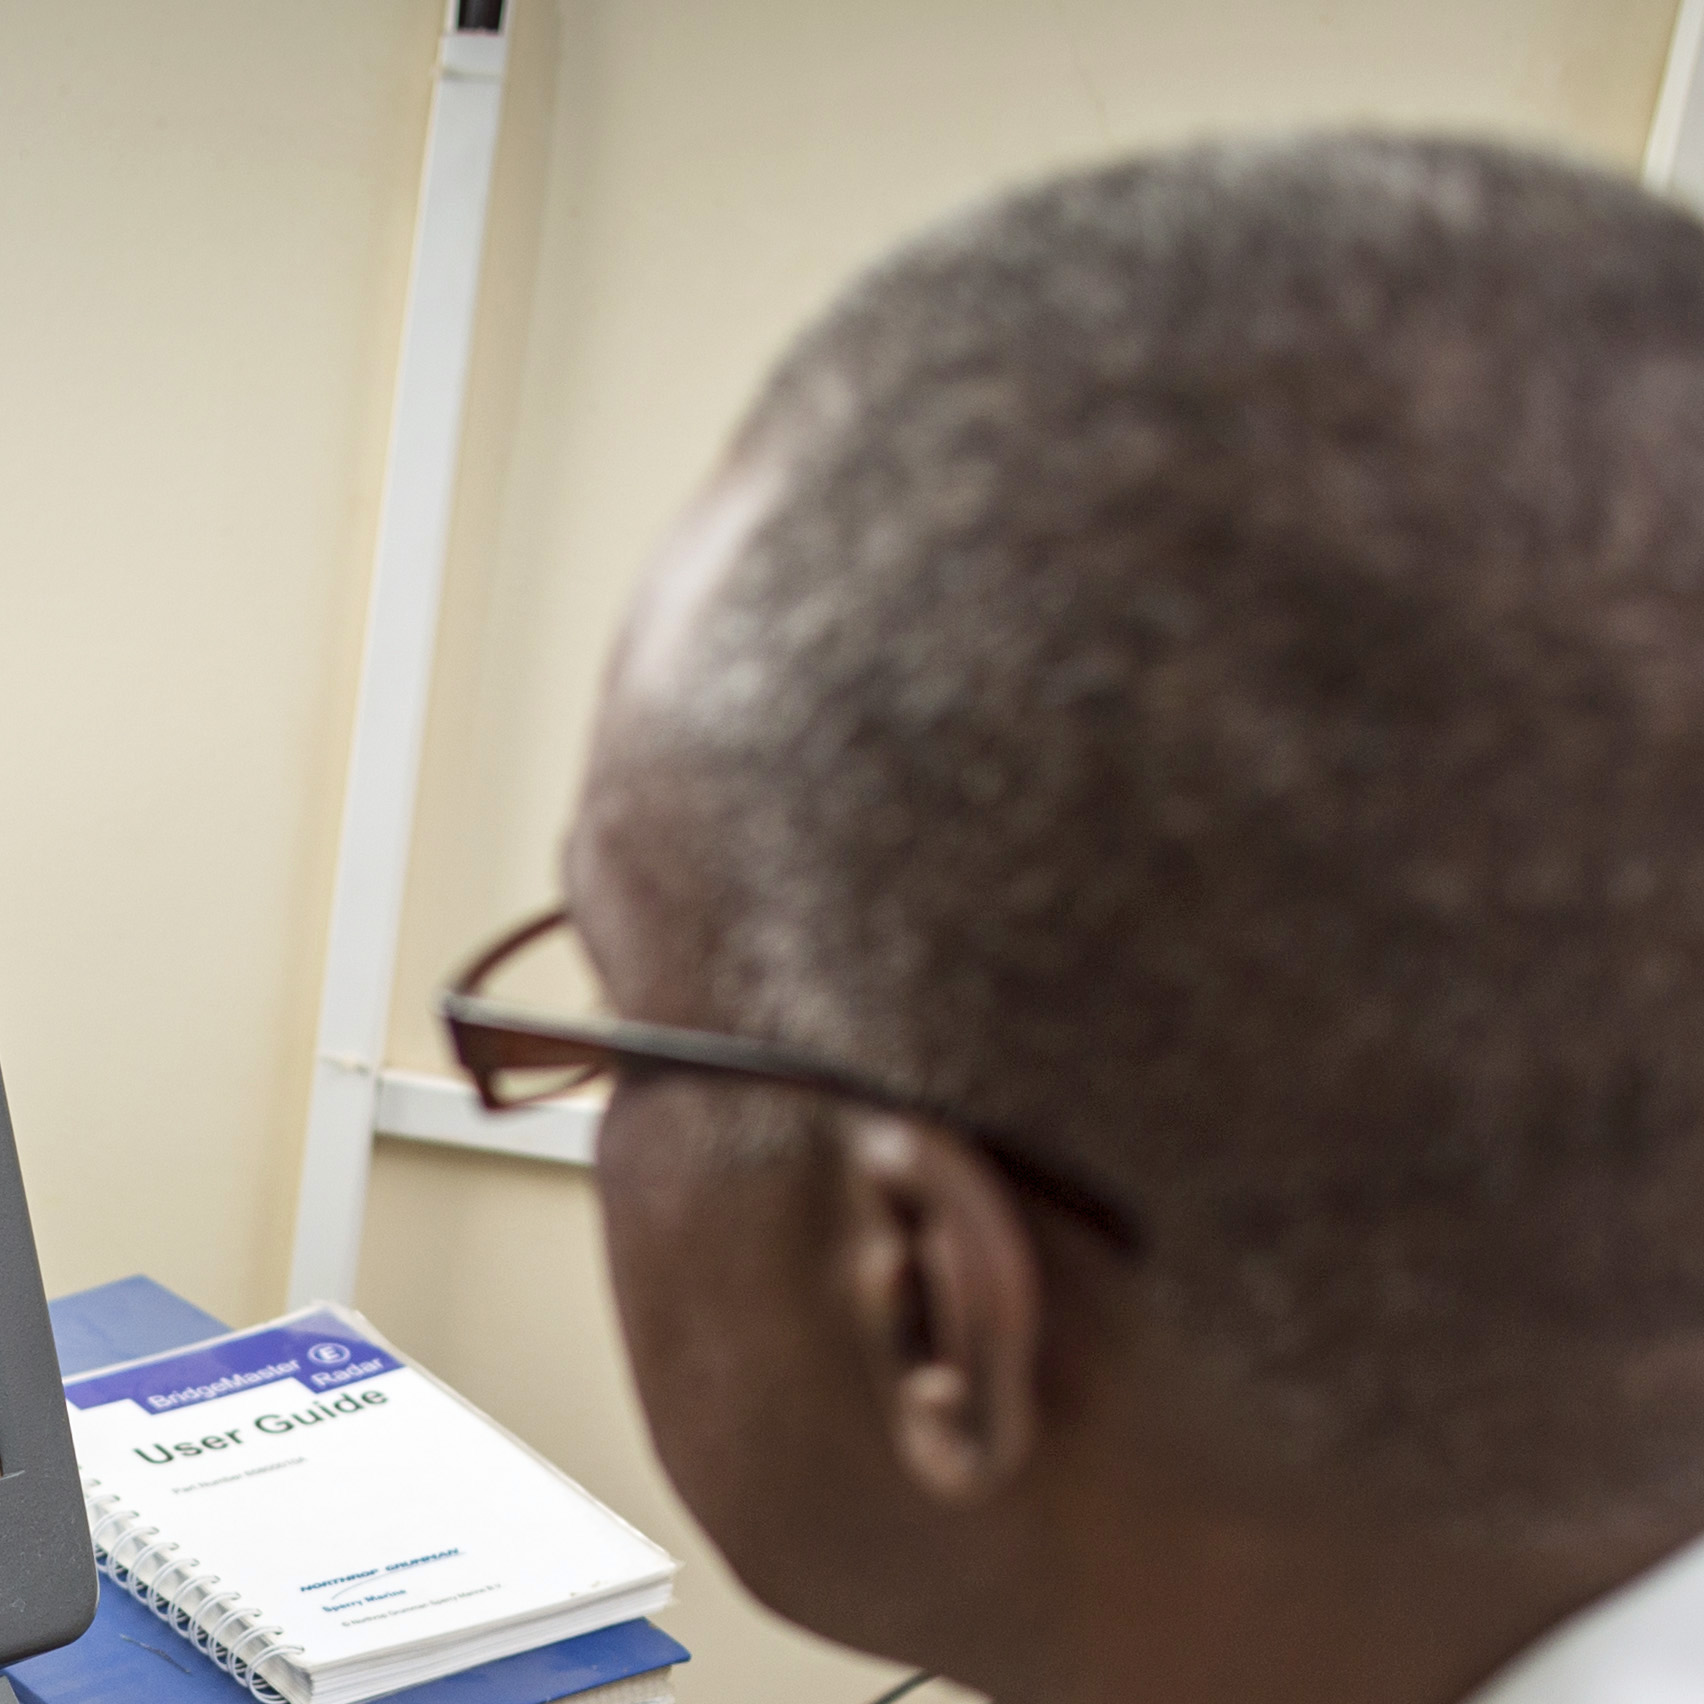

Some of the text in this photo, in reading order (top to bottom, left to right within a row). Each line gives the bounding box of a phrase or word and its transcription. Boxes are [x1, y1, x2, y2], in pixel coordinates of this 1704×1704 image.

[148, 1358, 301, 1410] BridgeMaster
[312, 1357, 384, 1388] Radar
[132, 1390, 390, 1466] User Guide
